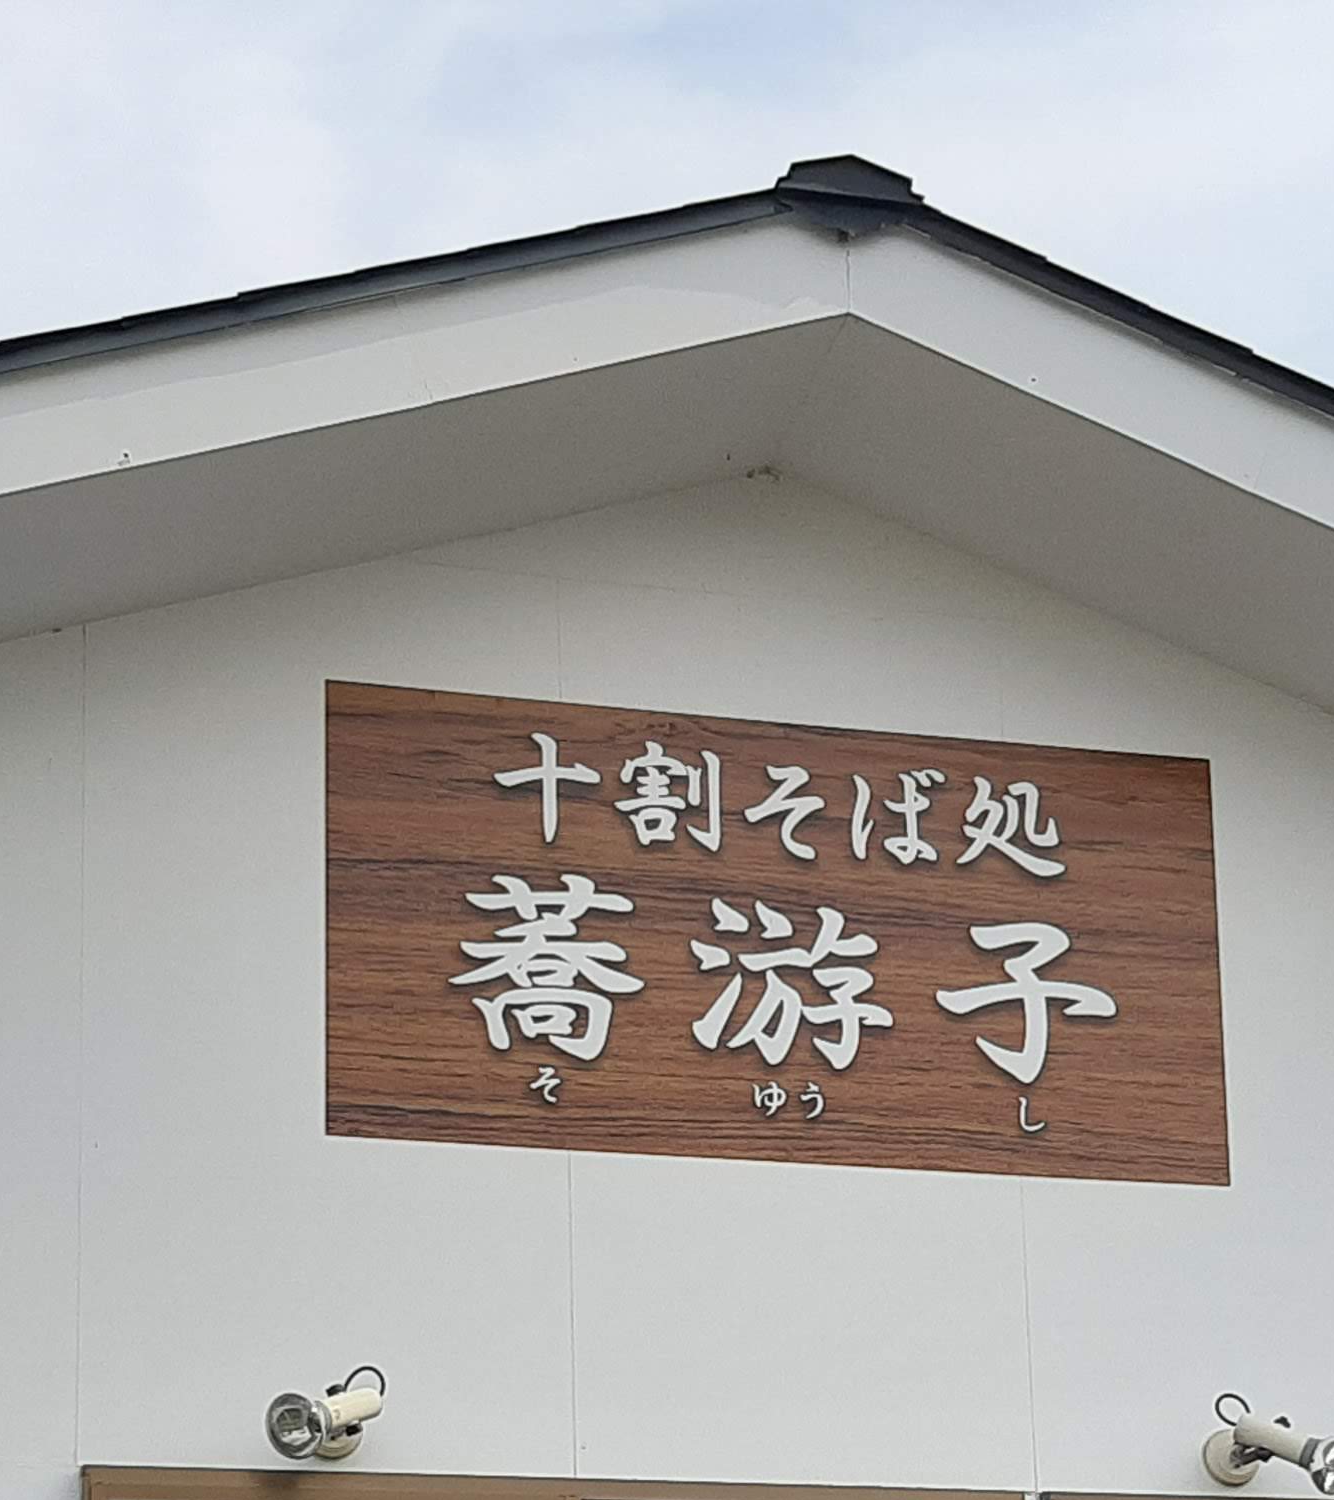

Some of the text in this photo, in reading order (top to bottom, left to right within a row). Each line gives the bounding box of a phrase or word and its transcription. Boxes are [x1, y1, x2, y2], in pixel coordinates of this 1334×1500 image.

[493, 732, 1066, 877] 十割そば処
[447, 873, 1117, 1085] 蕎游子
[529, 1066, 1045, 1133] そ ゆう し
